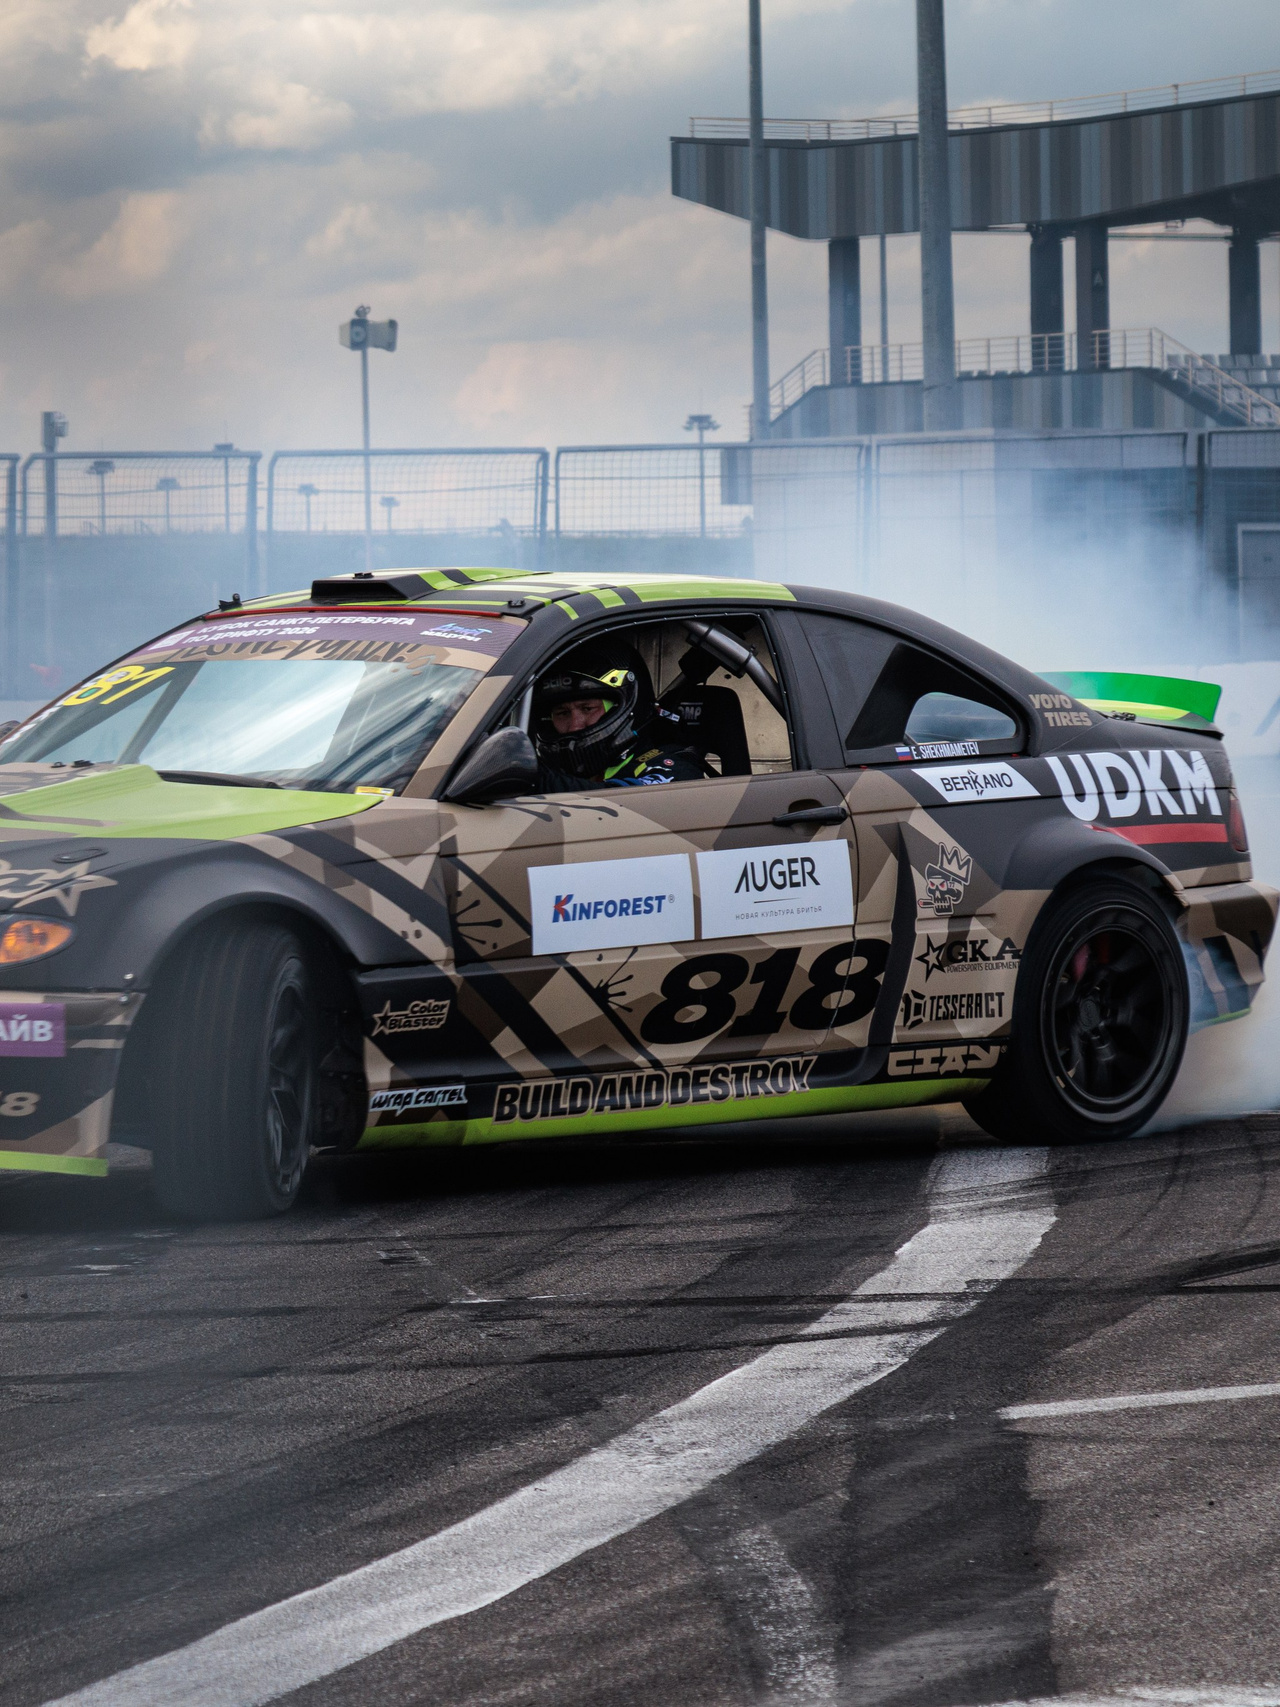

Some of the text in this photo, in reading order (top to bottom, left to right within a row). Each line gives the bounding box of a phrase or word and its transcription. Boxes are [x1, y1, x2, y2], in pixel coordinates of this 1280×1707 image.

[253, 616, 416, 627] САНКТ-ПЕТЕРБУРГА
[183, 626, 320, 644] ПО ДРИФТУ 2026
[1029, 693, 1073, 709] YOYO
[1043, 711, 1093, 727] TIRES
[940, 769, 1013, 796] BERKANO
[1044, 749, 1223, 823] UDKM
[734, 856, 821, 894] AUGER
[735, 905, 823, 920] НОВАЯ КУЛЬТУРА БРИТЬЯ
[946, 960, 1020, 973] POWERSPORTS EQUIPMENT
[640, 939, 891, 1045] 818
[409, 1001, 448, 1015] Color
[929, 992, 1005, 1021] TESSERACT
[387, 1015, 446, 1031] Blaster
[492, 1055, 819, 1125] BUILD AND DESTROY
